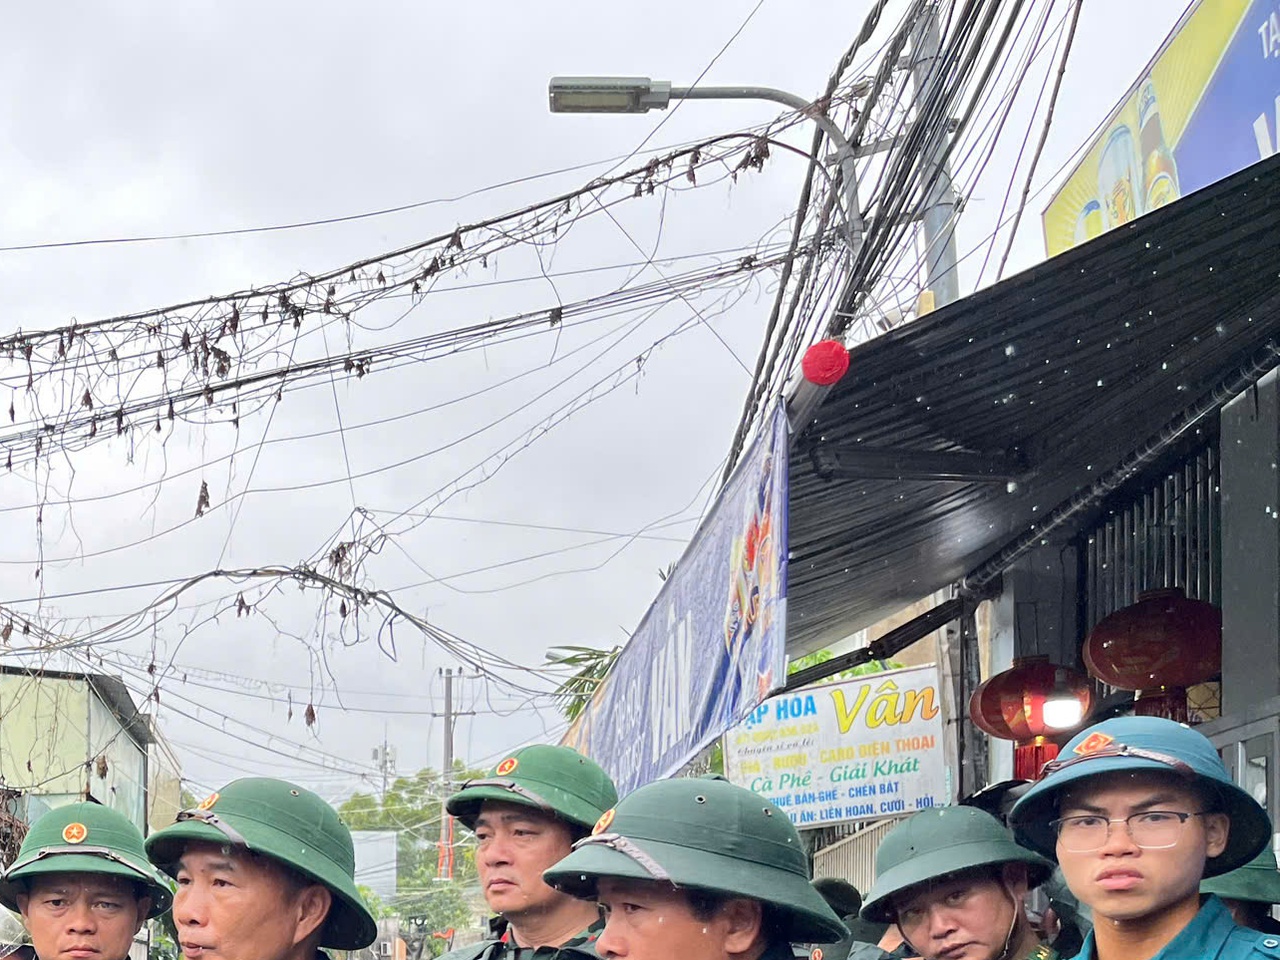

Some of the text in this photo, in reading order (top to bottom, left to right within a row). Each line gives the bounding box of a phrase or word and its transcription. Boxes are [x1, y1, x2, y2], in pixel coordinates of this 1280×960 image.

[744, 706, 770, 730] ẠP
[830, 679, 940, 734] Vân
[779, 769, 812, 789] Phê
[874, 756, 920, 777] Khát
